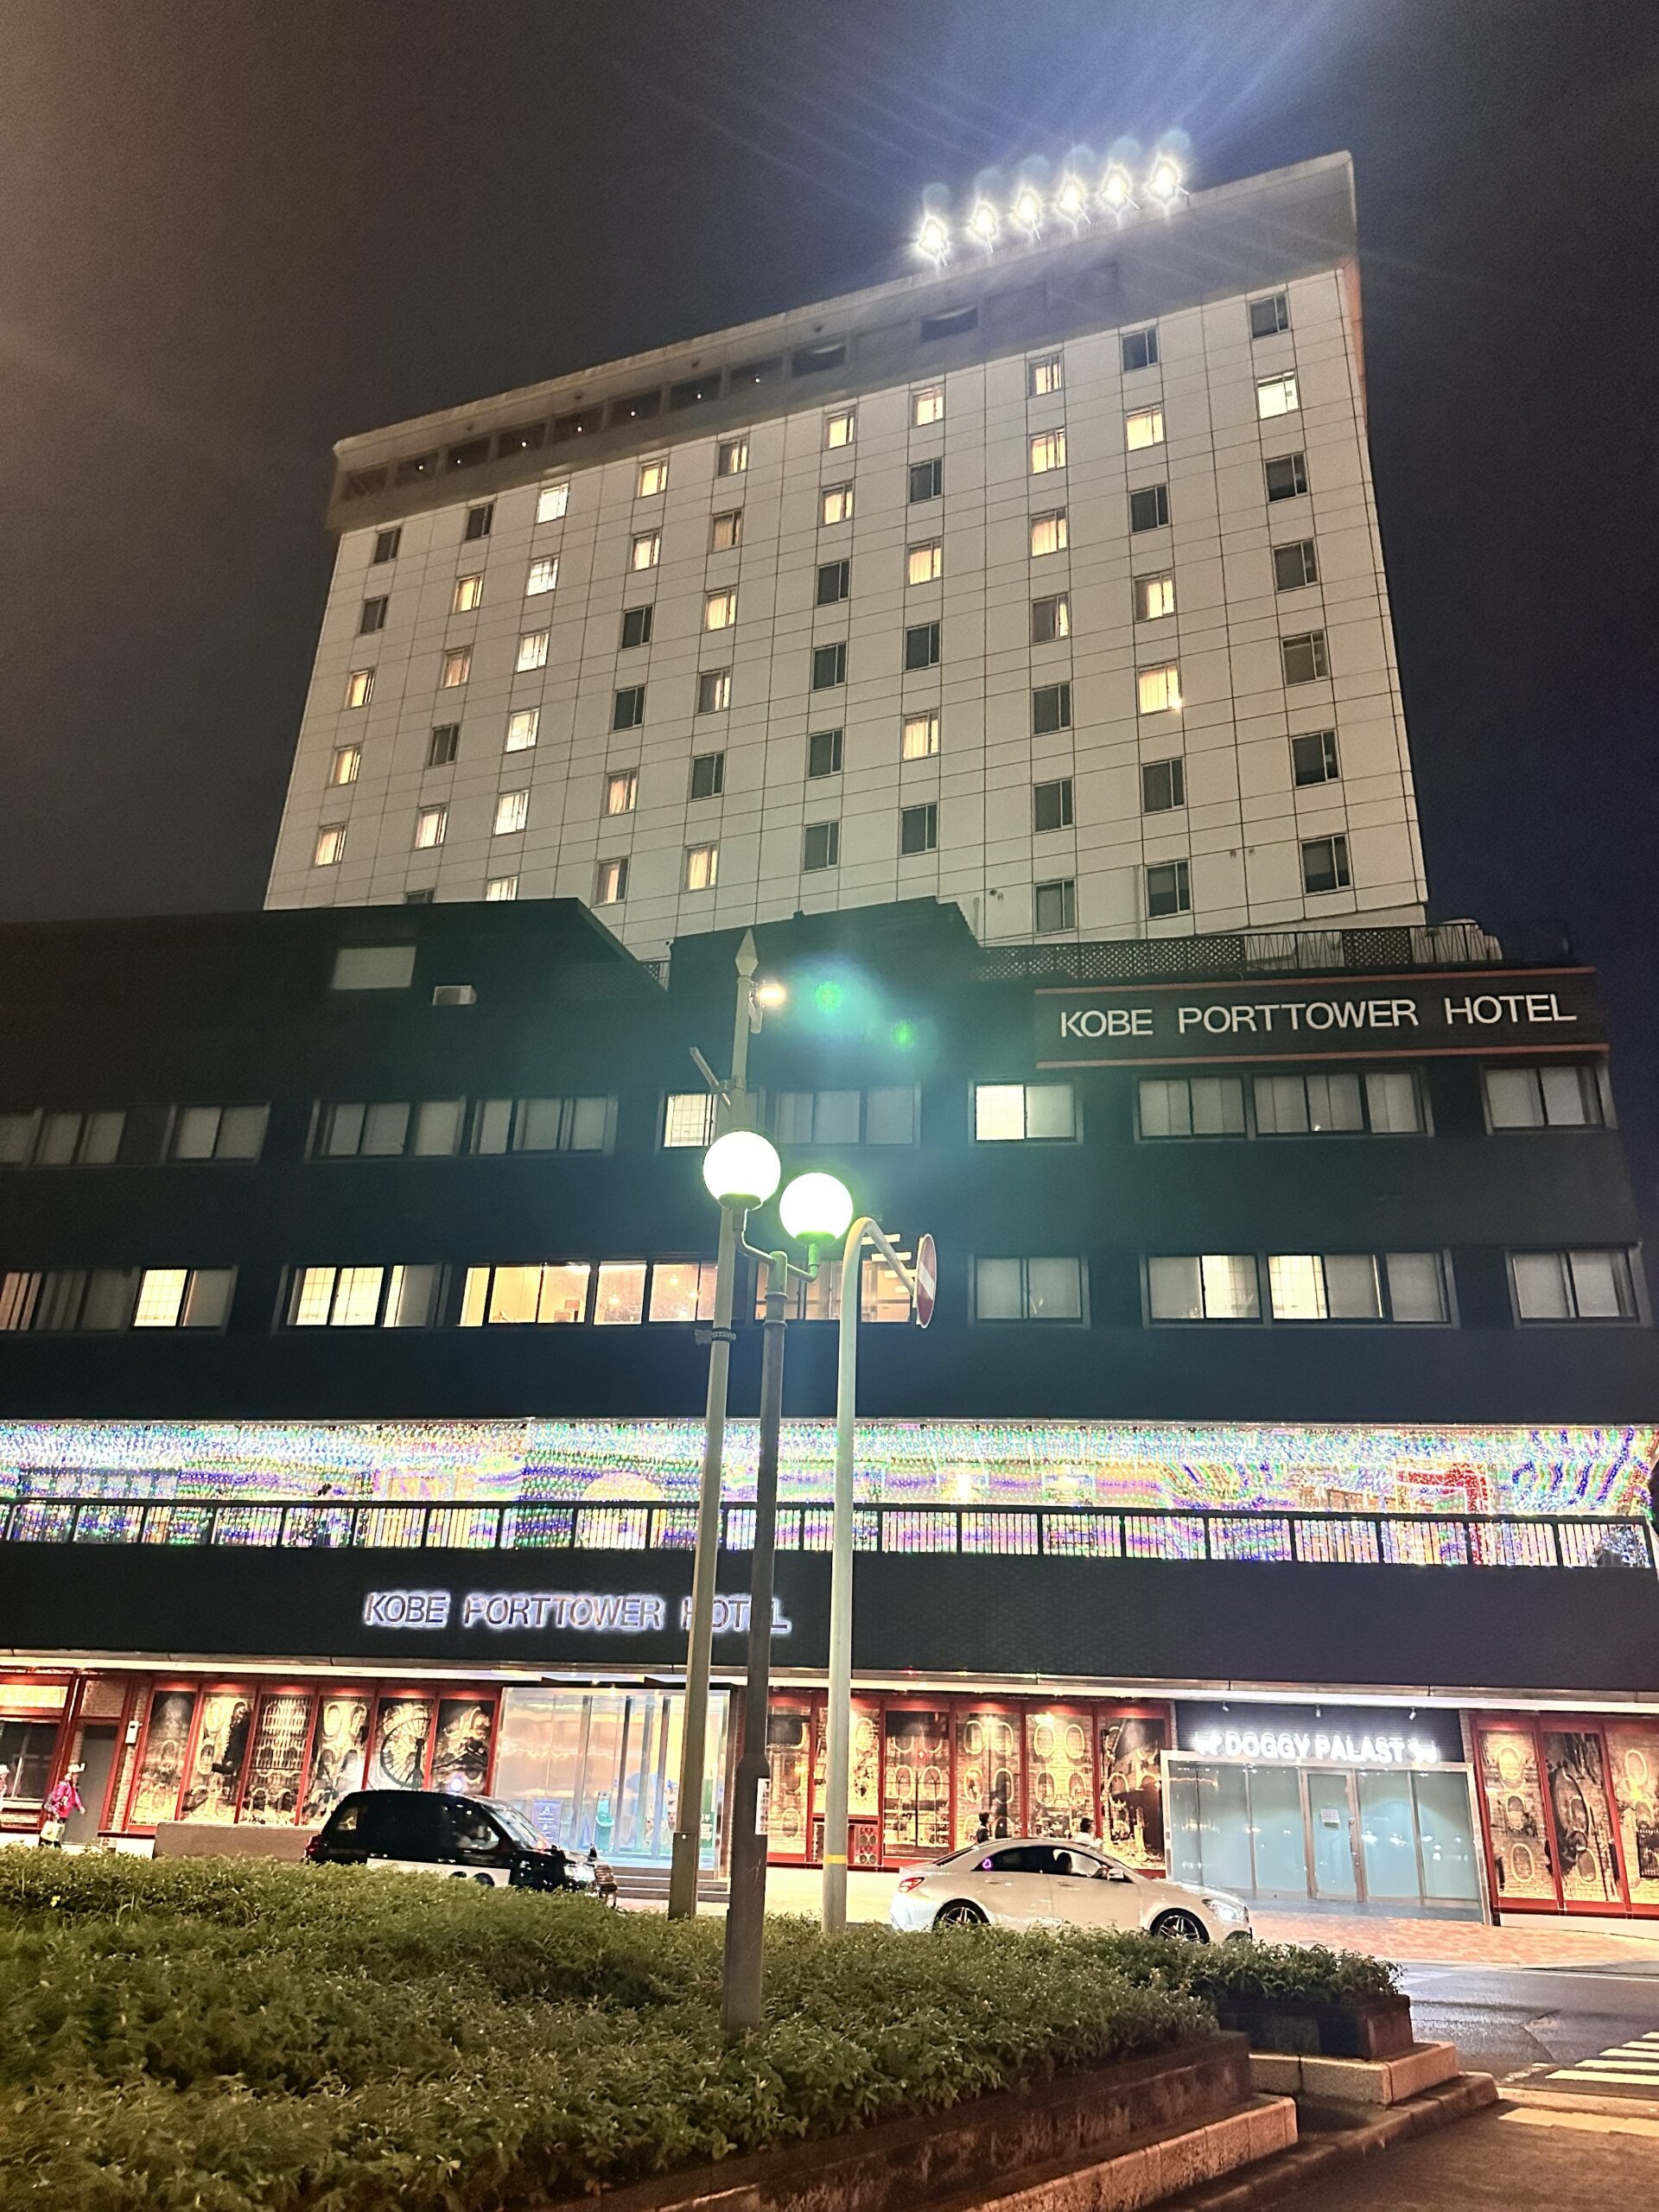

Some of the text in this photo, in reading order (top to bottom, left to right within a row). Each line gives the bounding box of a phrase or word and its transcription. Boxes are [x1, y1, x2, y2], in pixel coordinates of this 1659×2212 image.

[1061, 994, 1577, 1038] KOBE PORTTOWER HOTEL
[364, 1592, 791, 1631] KOBE PORTTOWER OTL
[1224, 1732, 1405, 1764] DOGGY PALAST
